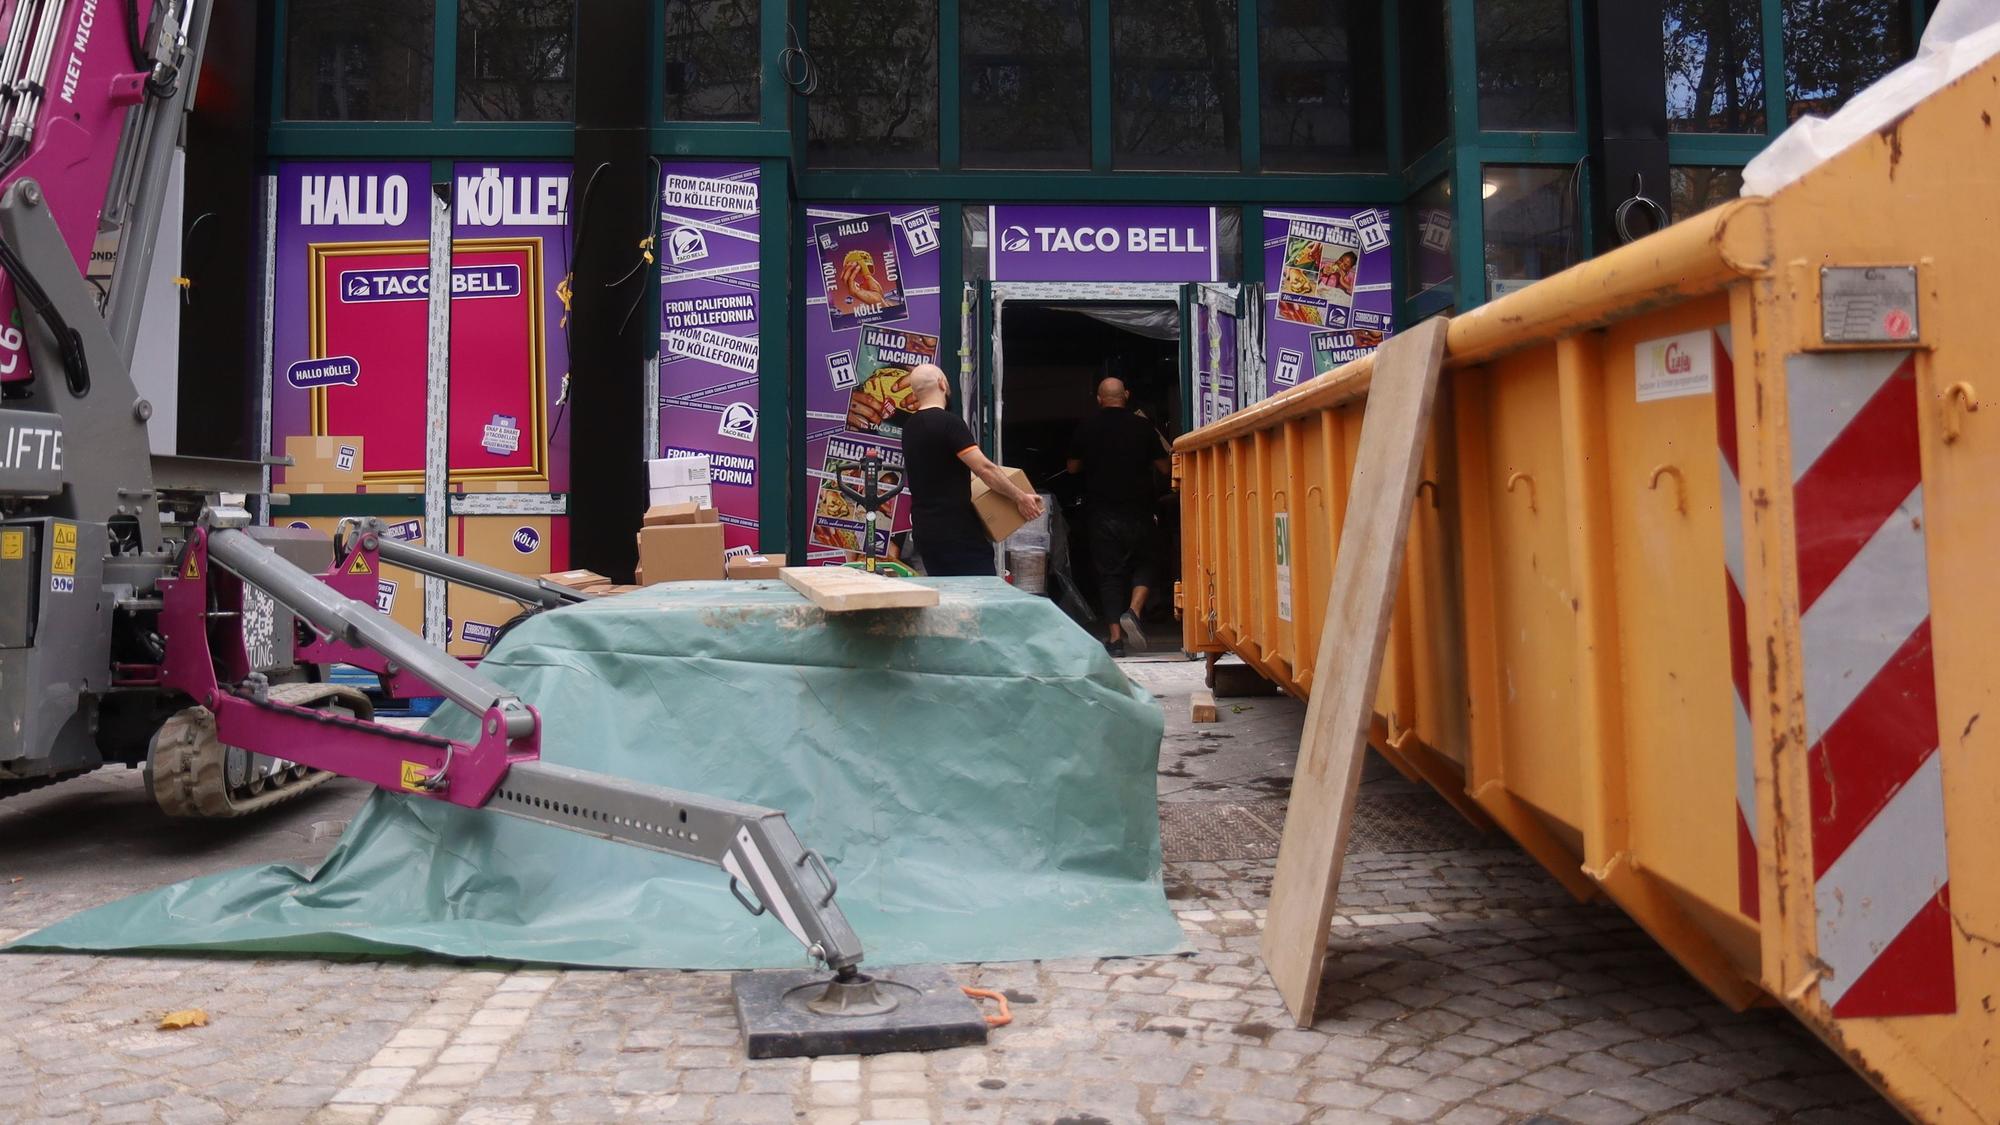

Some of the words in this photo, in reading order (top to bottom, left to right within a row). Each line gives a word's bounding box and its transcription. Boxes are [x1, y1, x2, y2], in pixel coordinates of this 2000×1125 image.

[60, 52, 82, 104] MIET
[670, 178, 696, 190] FROM
[698, 180, 755, 196] CALIFORNIA
[301, 175, 408, 226] HALLO
[457, 168, 568, 226] KÖLLE!
[669, 191, 681, 203] TO
[684, 192, 753, 210] KÖLLEFORNIA
[838, 221, 869, 236] HALLO
[908, 217, 924, 229] OBEN
[1291, 220, 1324, 240] HALLO
[1358, 216, 1376, 227] OBEN
[1035, 227, 1120, 252] TACO
[1128, 228, 1205, 252] BELL
[883, 251, 898, 281] HALLO
[452, 272, 511, 293] BELL
[822, 262, 838, 291] KÖLLE
[666, 301, 693, 313] FROM
[696, 296, 753, 310] CALIFORNIA
[853, 303, 883, 318] KÖLLE
[667, 316, 681, 327] TO
[684, 309, 754, 326] KÖLLEFORNIA
[703, 333, 758, 356] CALIFORNIA
[867, 332, 905, 349] HALLO
[1318, 334, 1354, 350] HALLO
[672, 338, 685, 351] TO
[687, 342, 754, 370] KÖLLEFORNIA
[832, 356, 848, 366] OBEN
[296, 368, 322, 380] HALLO
[323, 365, 351, 377] KÖLLE!
[869, 423, 891, 432] TACO
[0, 427, 62, 470] IFTE
[829, 440, 864, 461] HALLO
[699, 453, 754, 470] LIFORNIA
[514, 531, 538, 550] KÖLN
